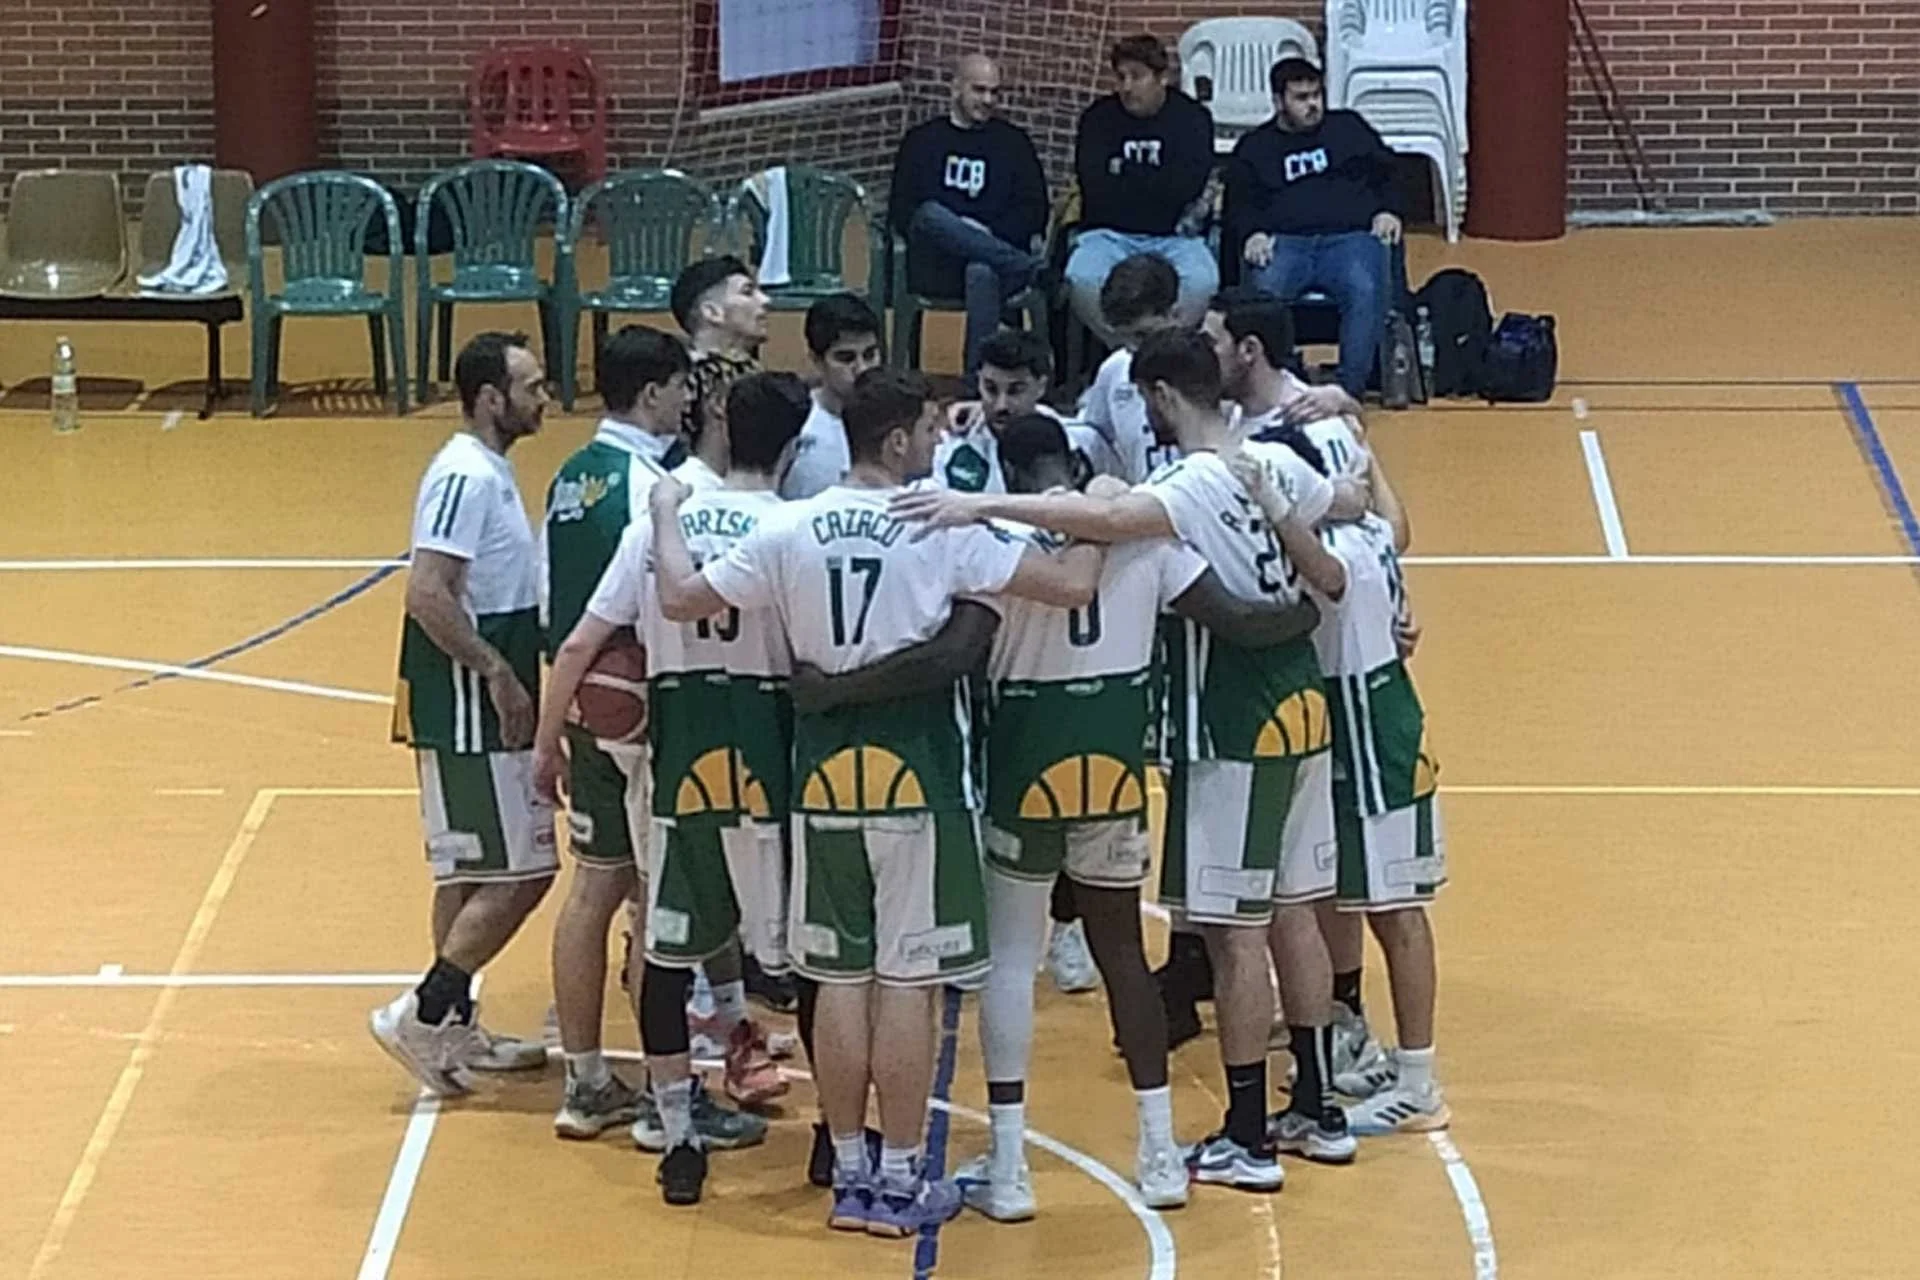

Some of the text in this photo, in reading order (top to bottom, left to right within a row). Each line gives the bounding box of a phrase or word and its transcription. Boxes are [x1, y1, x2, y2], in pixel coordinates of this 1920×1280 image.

[1284, 148, 1329, 181] CCB
[812, 508, 905, 548] CAZACU
[826, 556, 883, 646] 17
